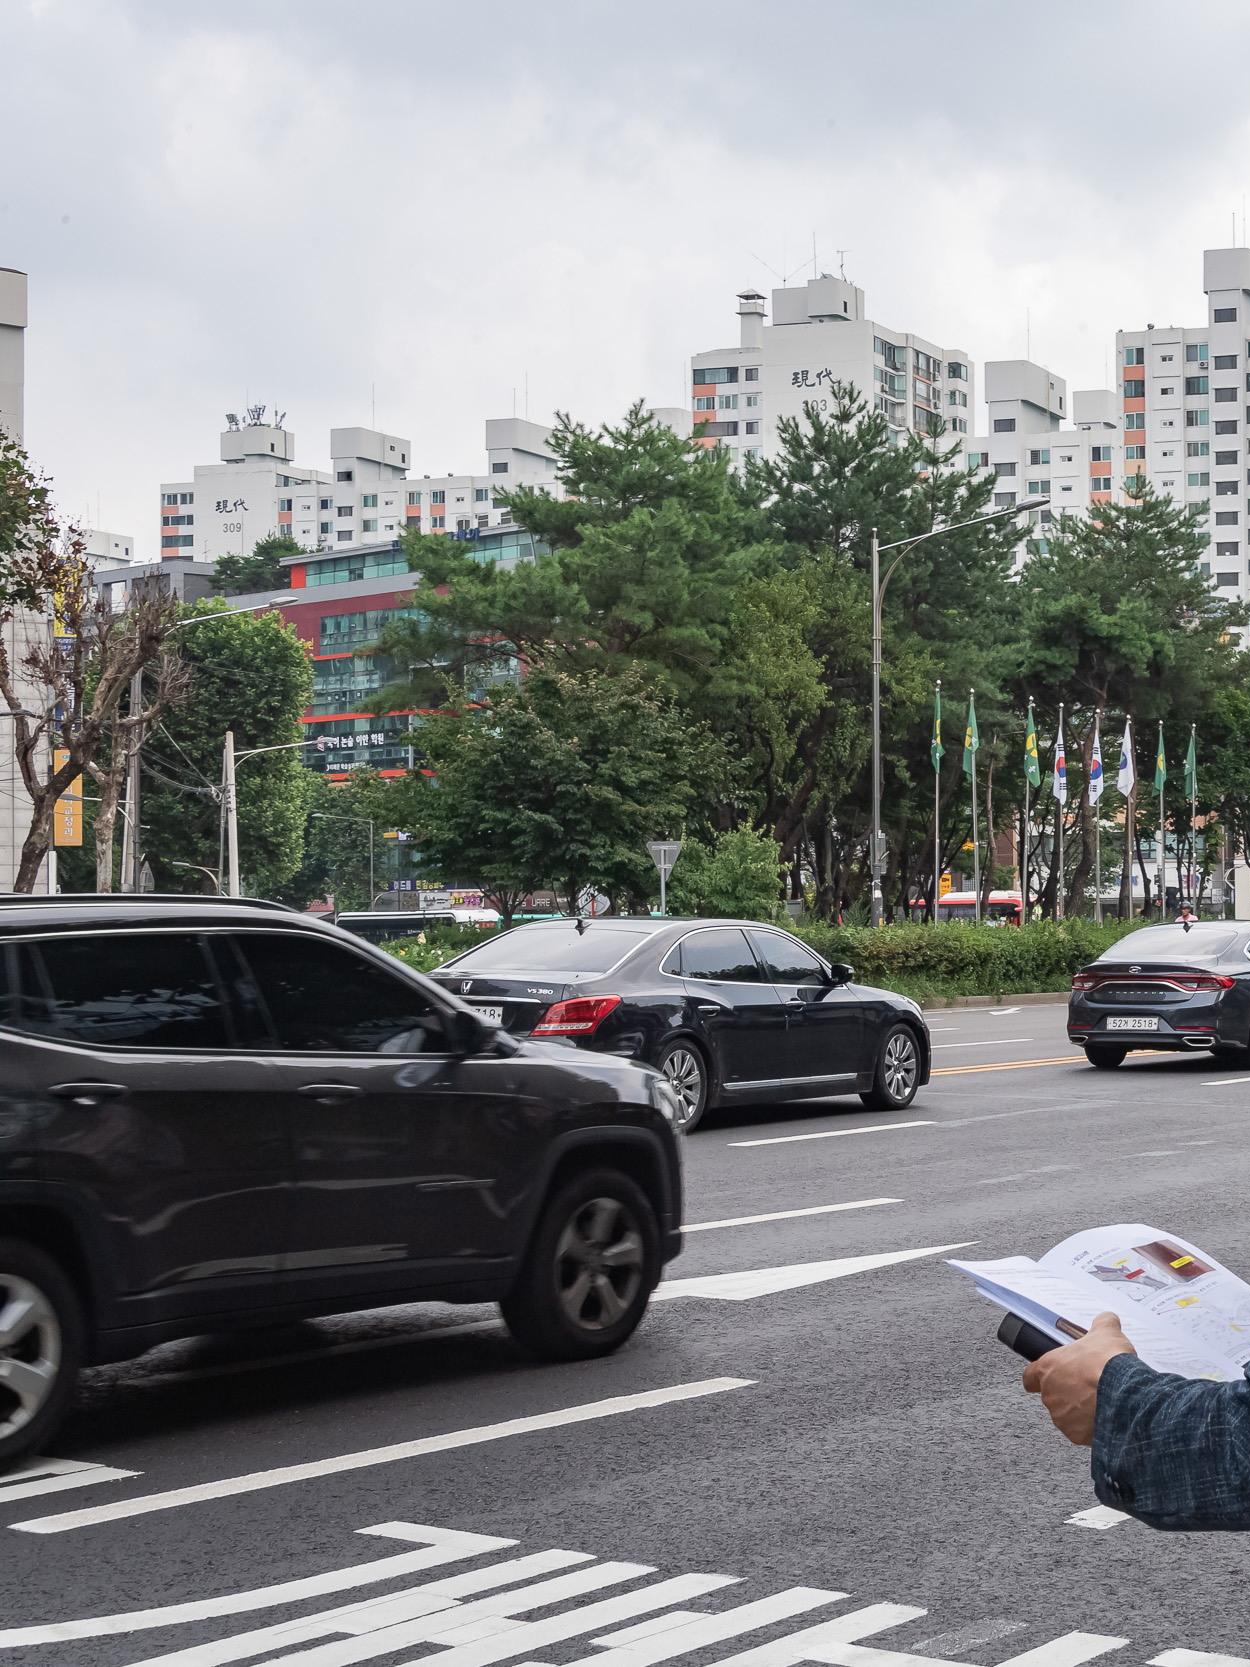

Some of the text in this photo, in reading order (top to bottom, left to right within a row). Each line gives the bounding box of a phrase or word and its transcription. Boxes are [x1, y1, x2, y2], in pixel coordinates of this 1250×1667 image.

[792, 368, 839, 388] 現代
[215, 498, 249, 513] 現代
[223, 522, 241, 532] 309
[341, 735, 354, 748] 논술
[371, 732, 384, 745] 학원
[1132, 1019, 1153, 1028] 2518
